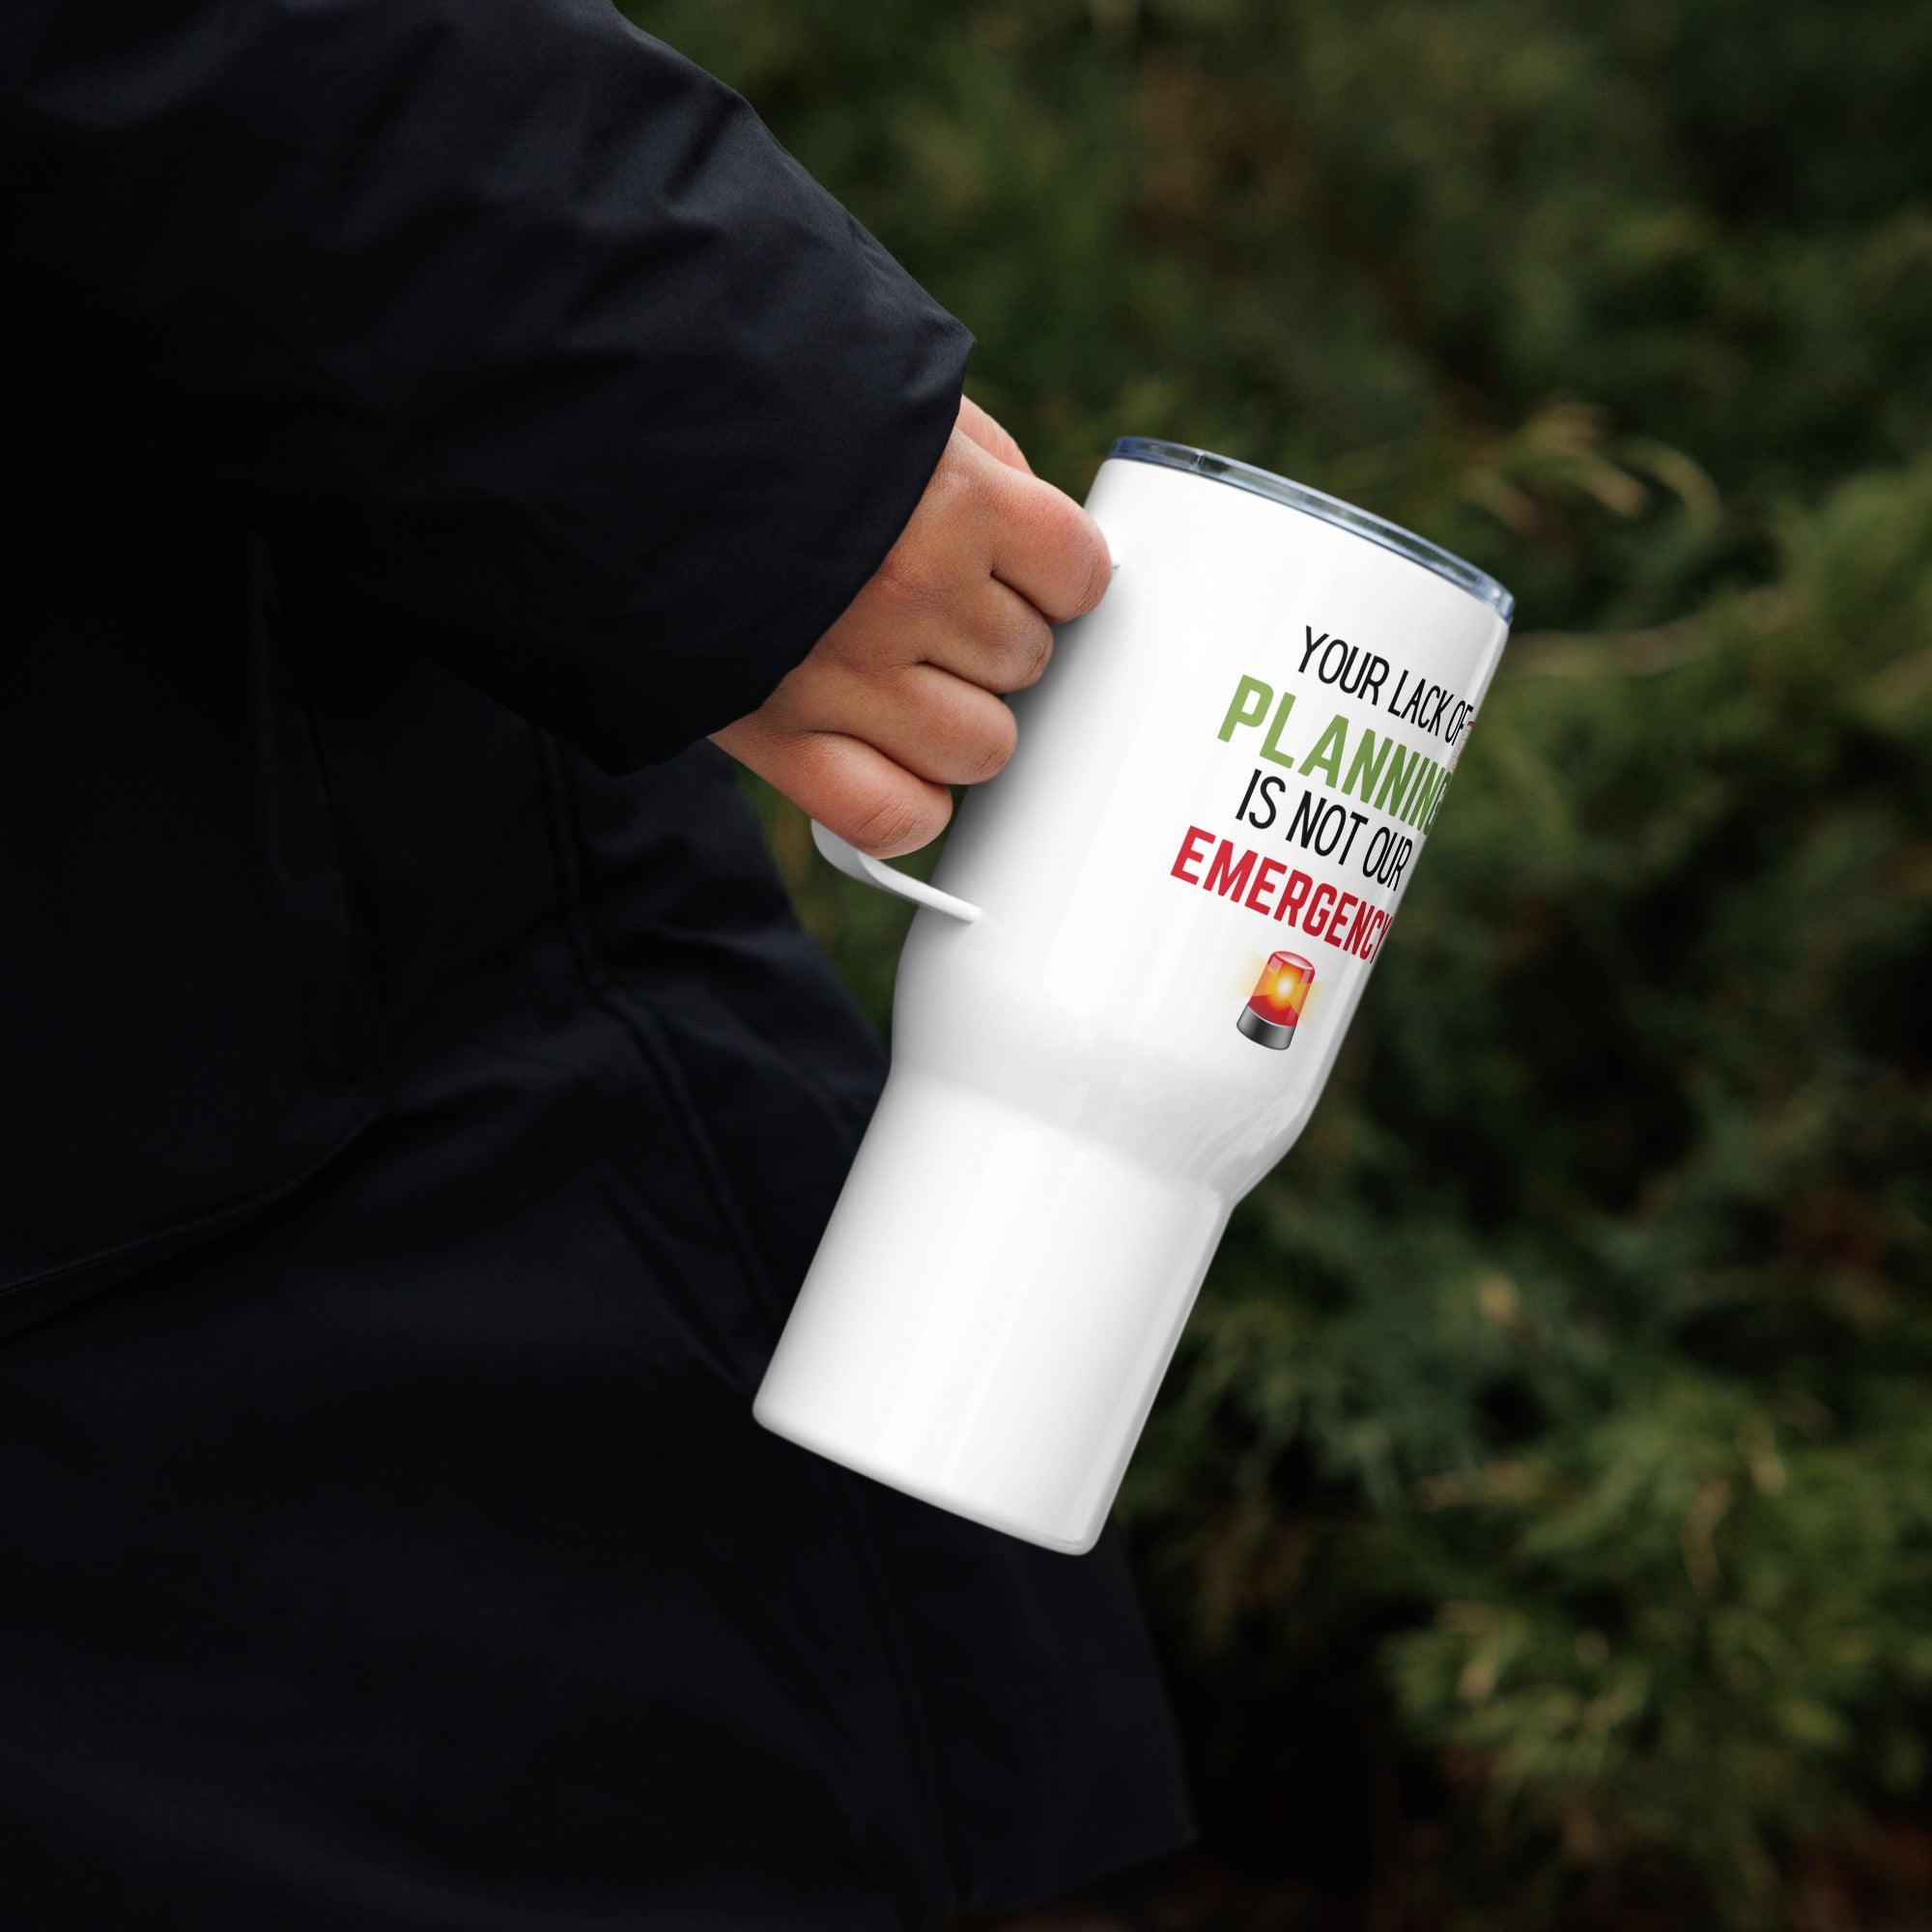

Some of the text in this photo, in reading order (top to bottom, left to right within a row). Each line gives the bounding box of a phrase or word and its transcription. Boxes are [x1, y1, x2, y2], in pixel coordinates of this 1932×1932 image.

[1297, 625, 1474, 746] YOUR LACK OF
[1235, 769, 1413, 892] IS NOT OUR
[1170, 825, 1393, 964] EMERGENCY
